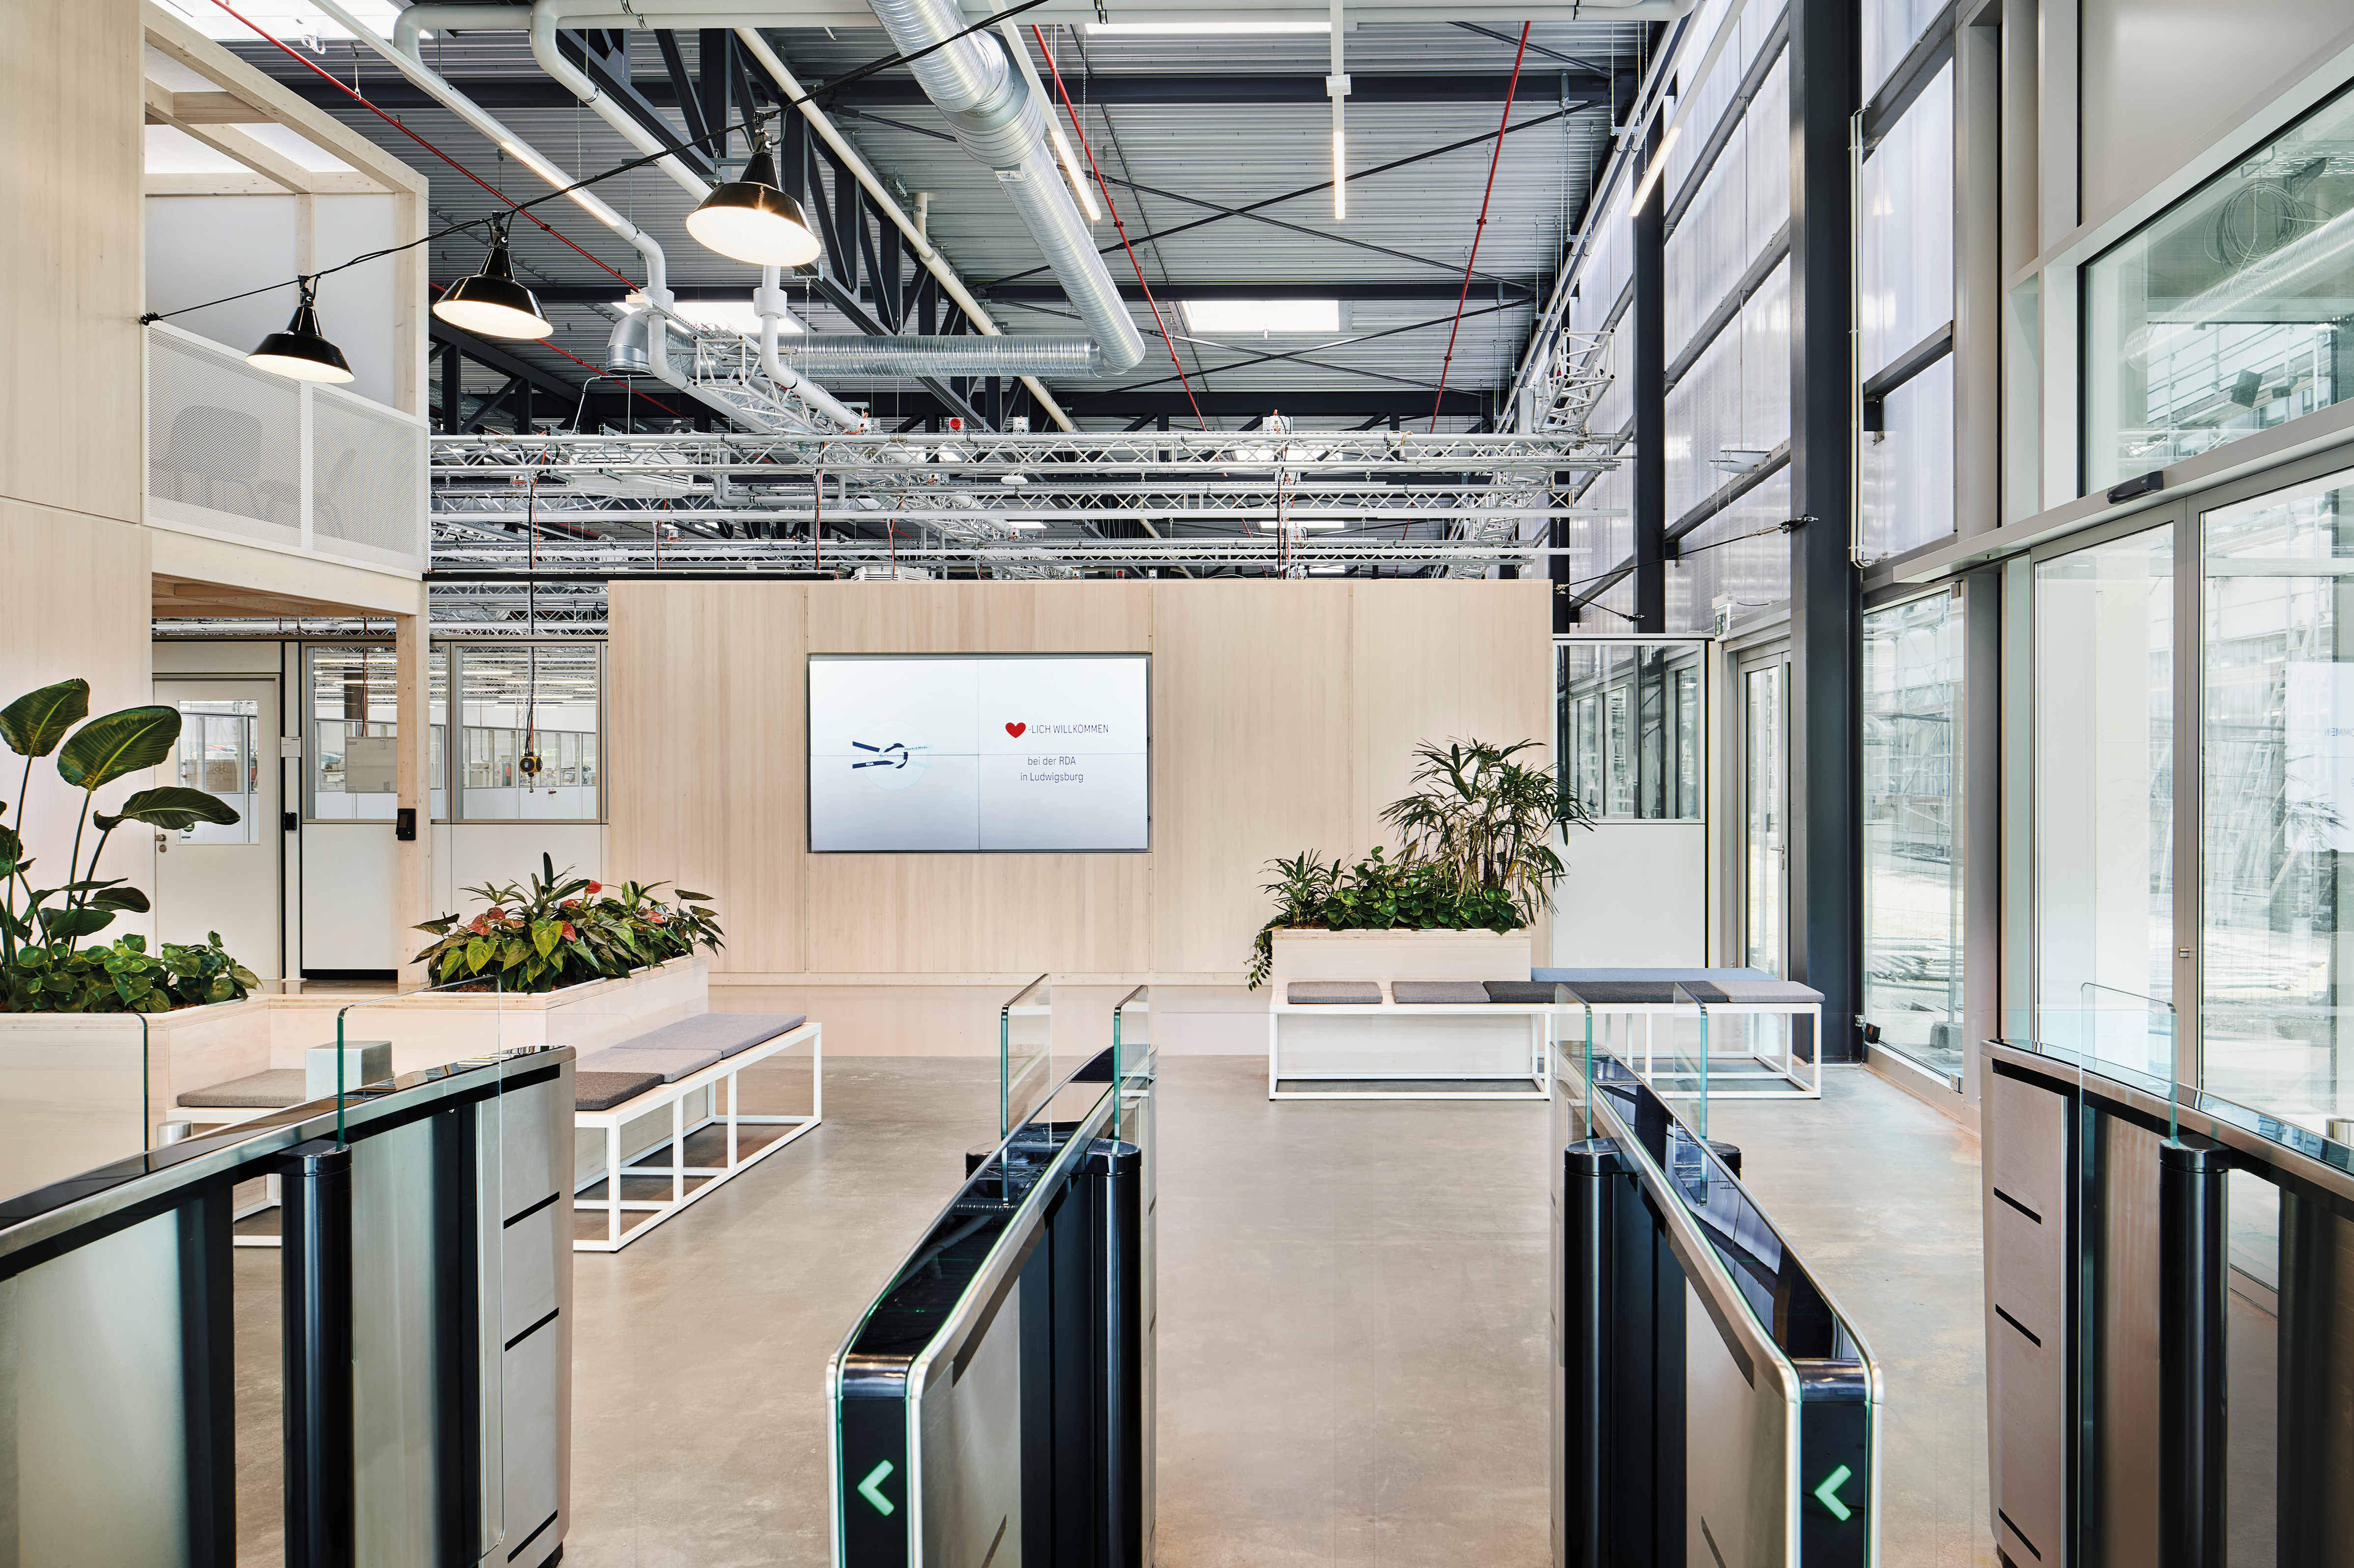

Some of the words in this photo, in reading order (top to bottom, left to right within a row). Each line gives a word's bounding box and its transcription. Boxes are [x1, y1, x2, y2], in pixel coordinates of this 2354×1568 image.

[1053, 724, 1109, 733] WILLKOMMEN
[1028, 756, 1040, 765] bei
[1043, 756, 1056, 765] der
[1059, 756, 1076, 765] RDA
[1020, 772, 1028, 781] in
[1030, 772, 1083, 783] Ludwigsburg
